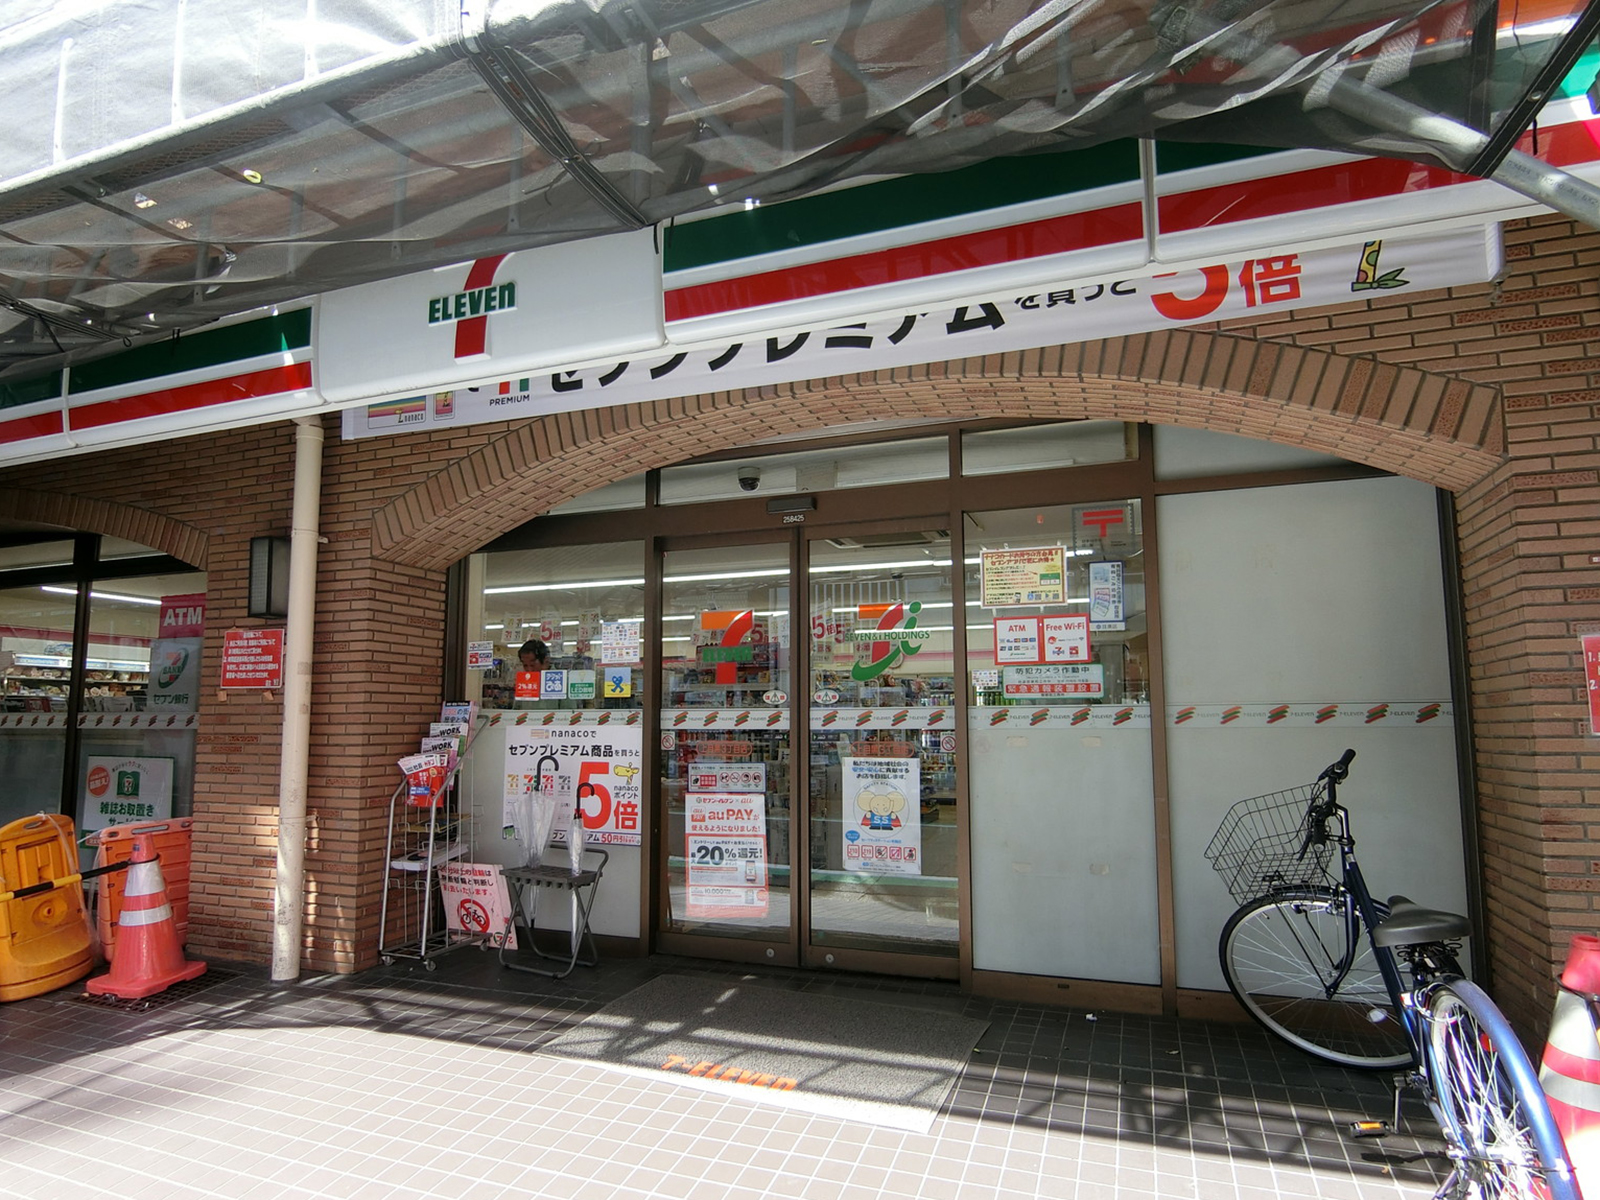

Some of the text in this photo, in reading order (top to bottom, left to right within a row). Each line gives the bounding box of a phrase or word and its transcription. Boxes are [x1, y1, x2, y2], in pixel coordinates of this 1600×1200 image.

[489, 394, 530, 406] PREMIUM
[782, 514, 805, 524] 258425
[163, 606, 203, 627] ATM
[1008, 624, 1026, 633] ATM
[1046, 622, 1085, 631] Free Wi-Fi
[884, 630, 930, 640] HOLDINGS
[1015, 666, 1090, 675] 防犯カメラ作動中
[153, 693, 190, 705] セブン銀行
[509, 744, 640, 758] セブンプレミアム商品を買うと
[99, 801, 155, 817] 雑誌お取置き
[614, 800, 638, 830] 倍
